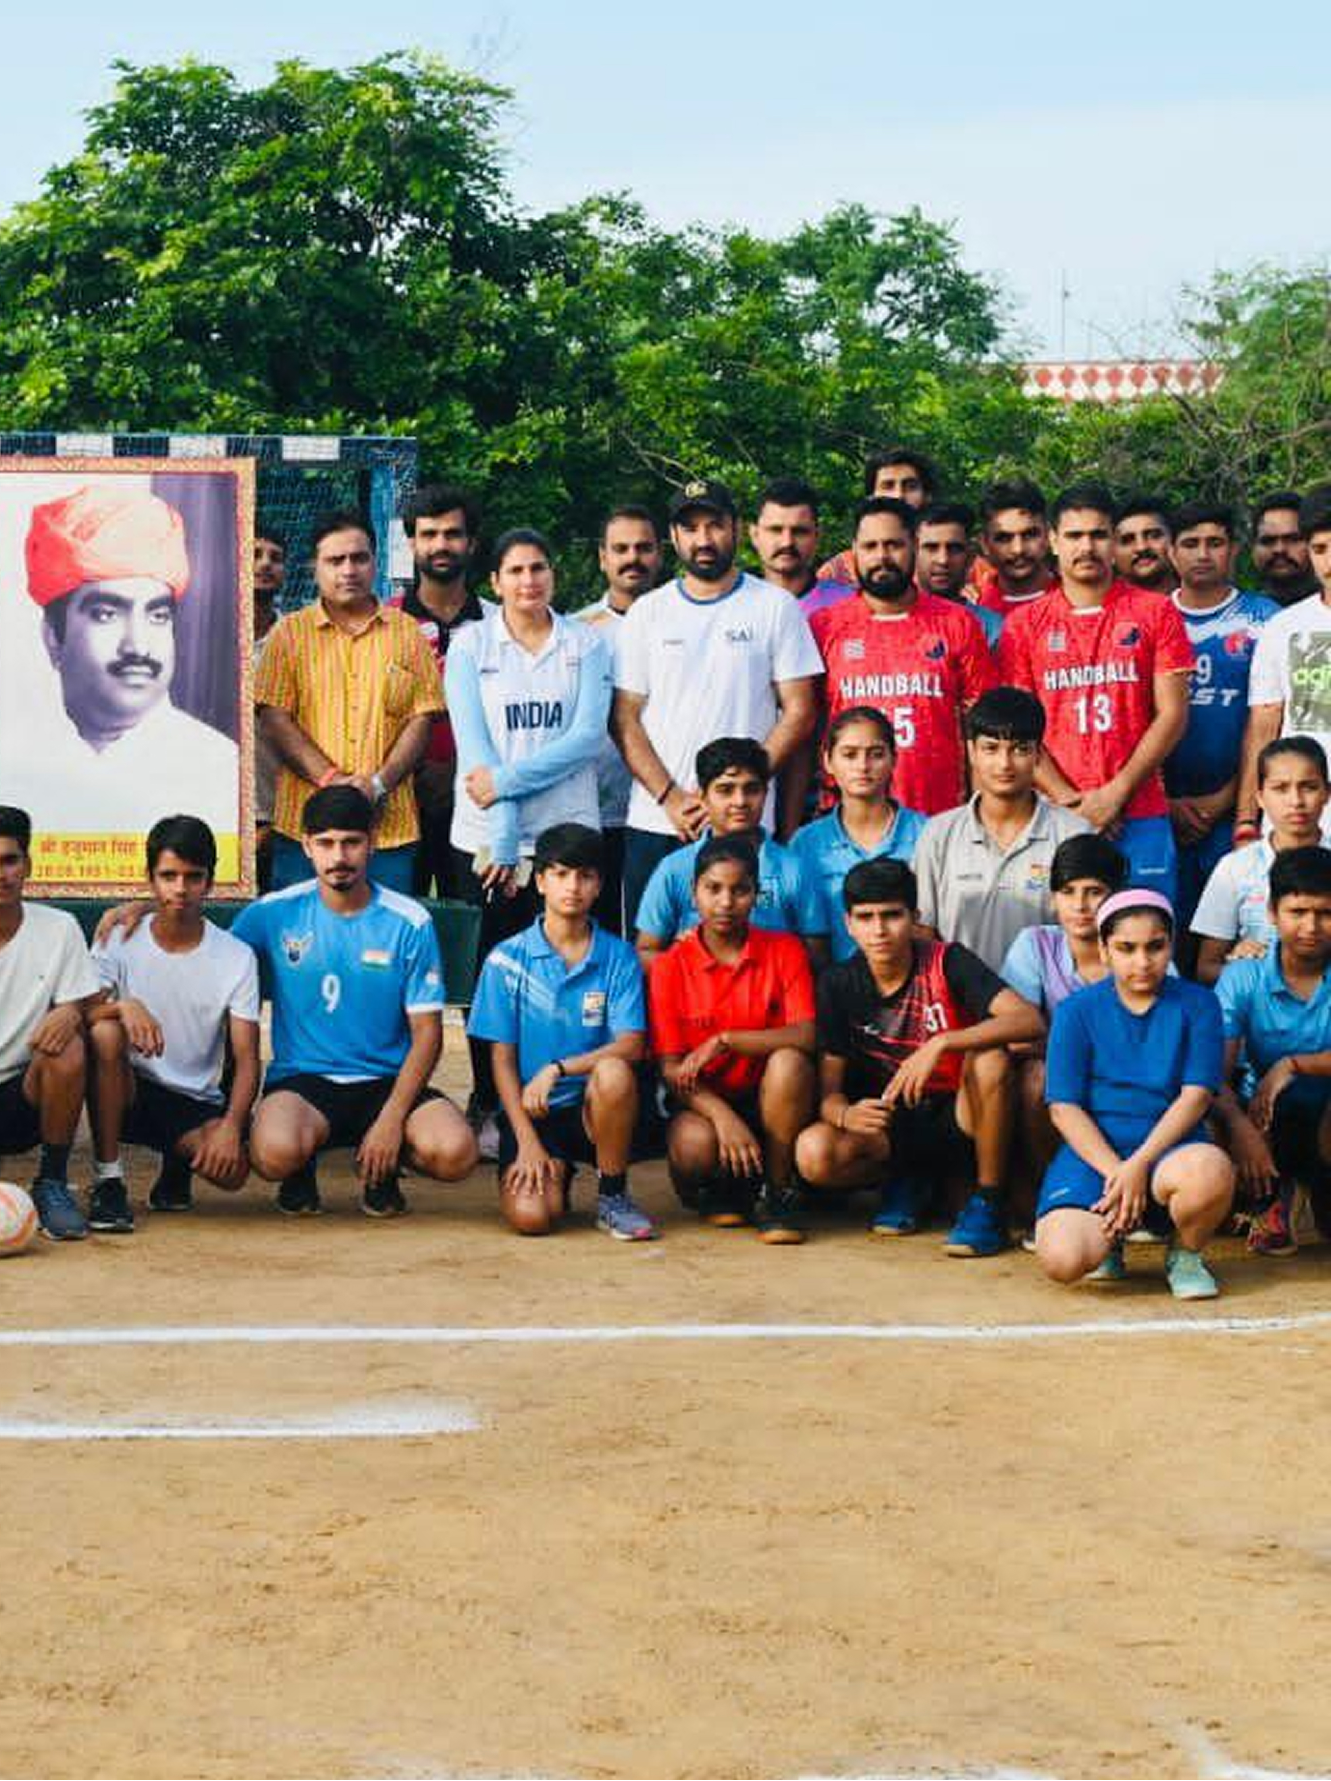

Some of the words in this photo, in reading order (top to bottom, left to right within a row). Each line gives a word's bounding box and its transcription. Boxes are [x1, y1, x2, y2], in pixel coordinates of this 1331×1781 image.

[839, 672, 945, 700] HANDBALL
[1043, 655, 1140, 691] HANDBALL
[505, 701, 563, 731] INDIA
[1073, 694, 1112, 735] 13
[322, 974, 341, 1015] 9
